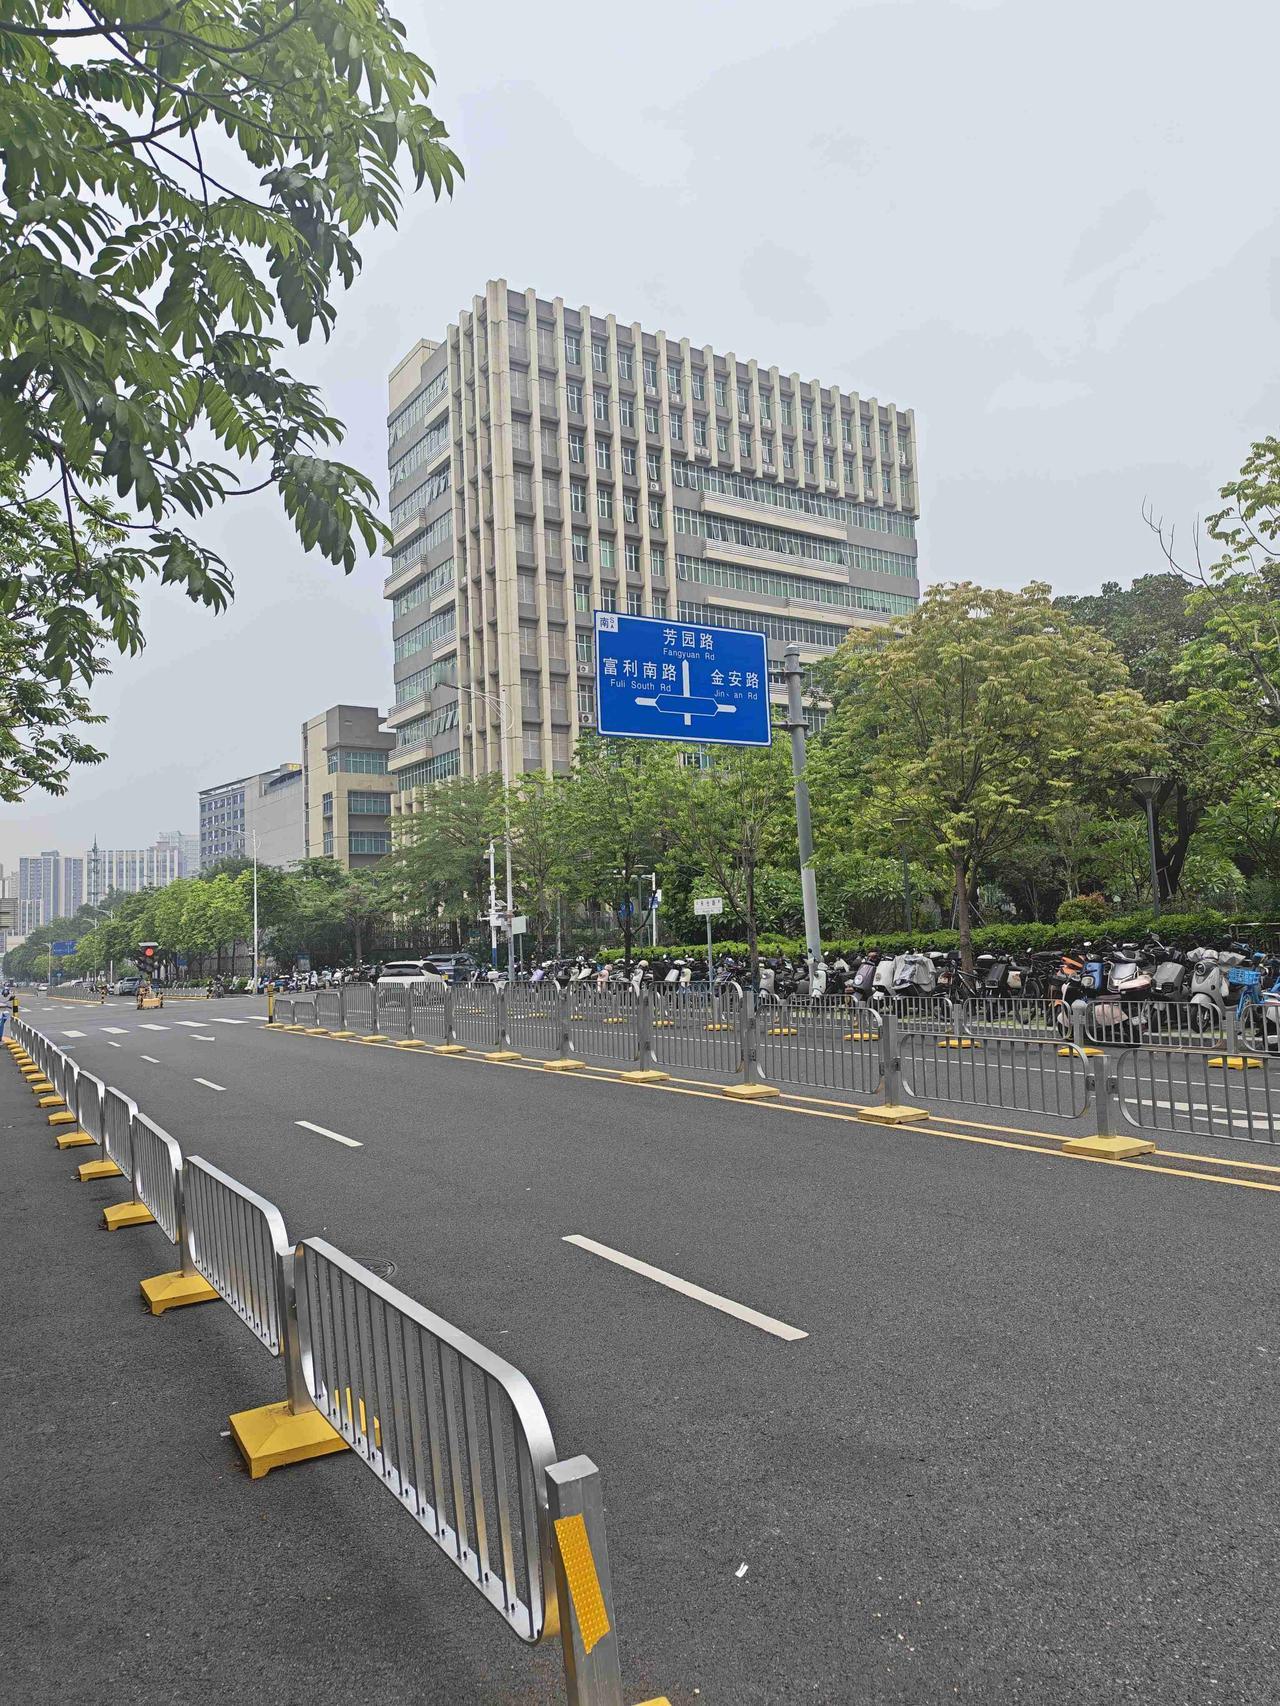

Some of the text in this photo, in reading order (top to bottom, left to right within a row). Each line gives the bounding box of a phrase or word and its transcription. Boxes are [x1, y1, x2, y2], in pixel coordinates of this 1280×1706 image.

[600, 617, 609, 629] 南
[663, 628, 714, 650] 芳园路
[663, 648, 715, 661] Fangyuan Rd
[603, 657, 677, 682] 富利南路
[610, 679, 672, 692] Fuli South Rd
[711, 669, 759, 689] 金安路
[747, 692, 758, 701] Rd
